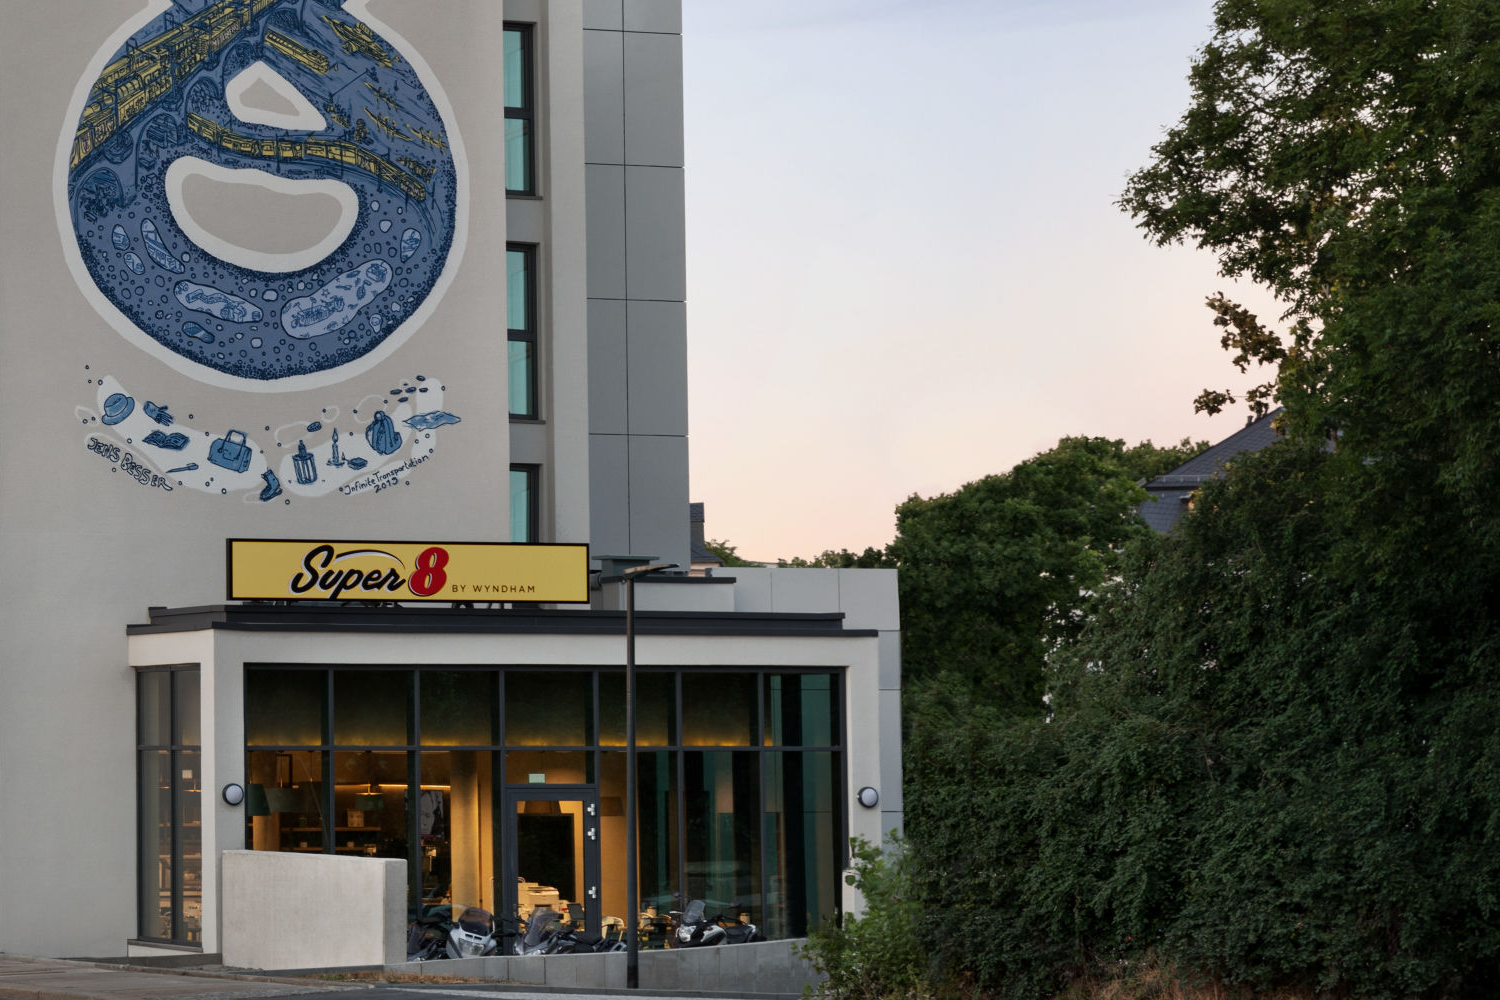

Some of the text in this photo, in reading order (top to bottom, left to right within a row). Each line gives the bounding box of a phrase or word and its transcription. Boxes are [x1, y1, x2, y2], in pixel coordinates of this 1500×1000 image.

[87, 437, 173, 492] JENS BESSER
[372, 454, 429, 482] Transportation
[373, 477, 399, 494] 2019
[289, 544, 536, 599] Super 8 BY WYNDHAM
